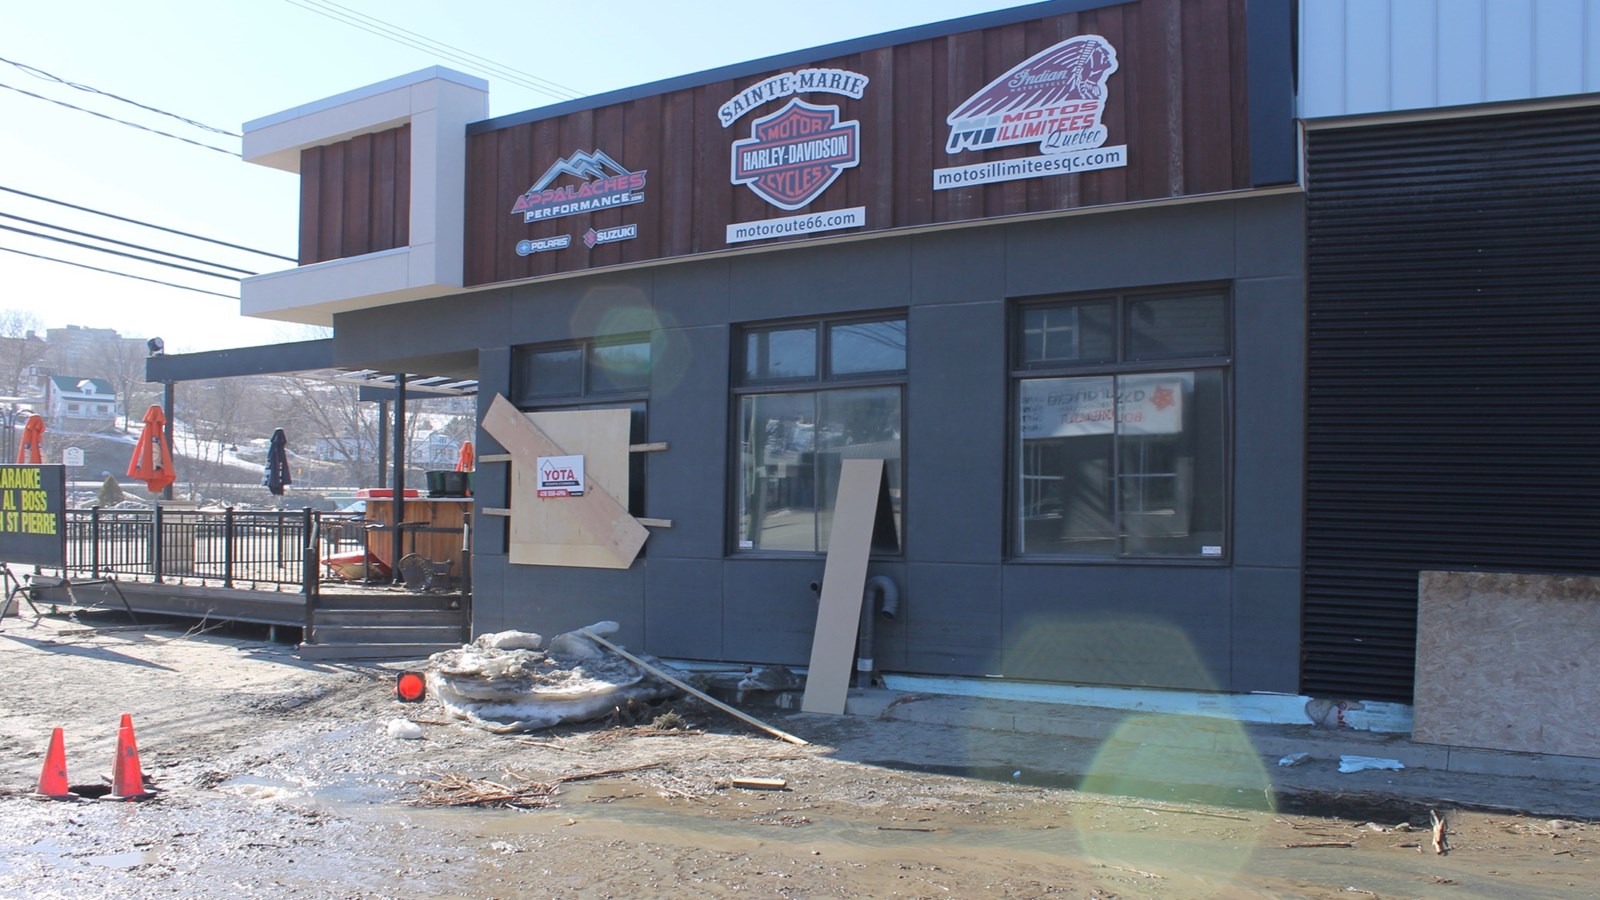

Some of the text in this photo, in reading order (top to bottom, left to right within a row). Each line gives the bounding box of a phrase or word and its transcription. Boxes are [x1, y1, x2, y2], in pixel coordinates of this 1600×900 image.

[1008, 69, 1068, 88] Indian
[721, 73, 865, 123] SAINTE MARIE
[1002, 101, 1098, 123] MOTOS
[767, 113, 823, 140] MOTOR
[743, 135, 848, 171] HARLEY-DAVIDSON
[938, 151, 1120, 184] motosillimiteesqc.com
[514, 174, 644, 210] APPALACHES
[766, 167, 823, 197] CYCLES
[526, 193, 629, 220] PERFORMANCE
[596, 227, 635, 241] SUZUKI
[736, 214, 855, 238] motoroute66.com
[531, 238, 568, 250] POLARIS
[0, 468, 40, 488] ARAOKE
[544, 469, 575, 480] YOTA
[3, 490, 47, 511] AL BOSS
[7, 511, 19, 532] ST
[22, 512, 56, 534] PIERRE
